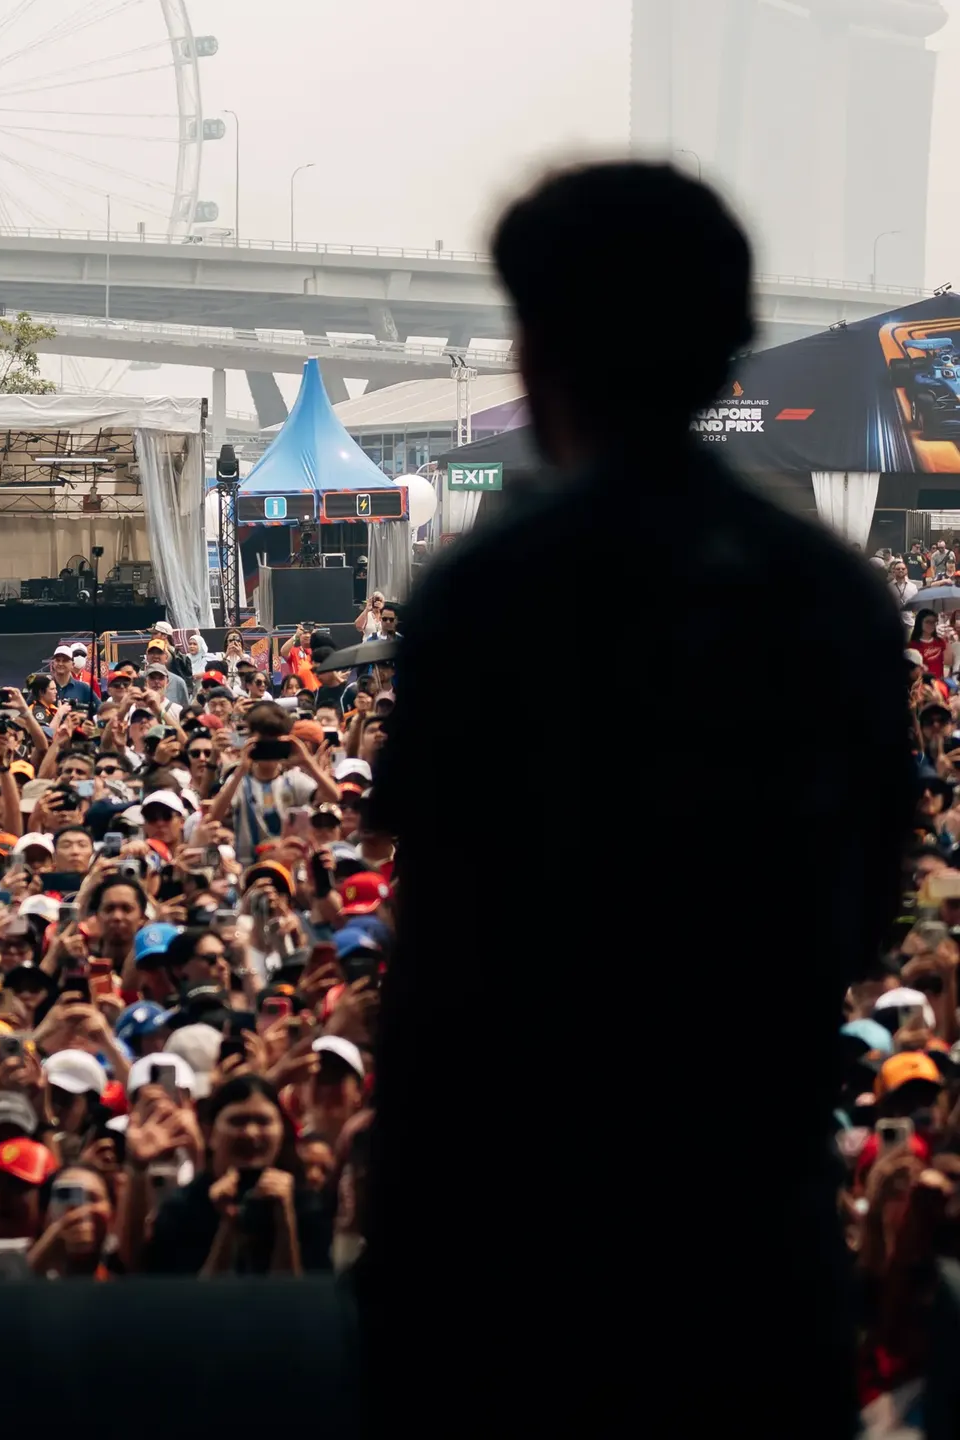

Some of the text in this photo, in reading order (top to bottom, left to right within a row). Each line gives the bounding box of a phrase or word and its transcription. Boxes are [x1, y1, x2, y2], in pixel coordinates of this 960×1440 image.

[689, 420, 765, 432] AND PRIX
[702, 434, 728, 442] 2026
[451, 469, 499, 485] EXIT
